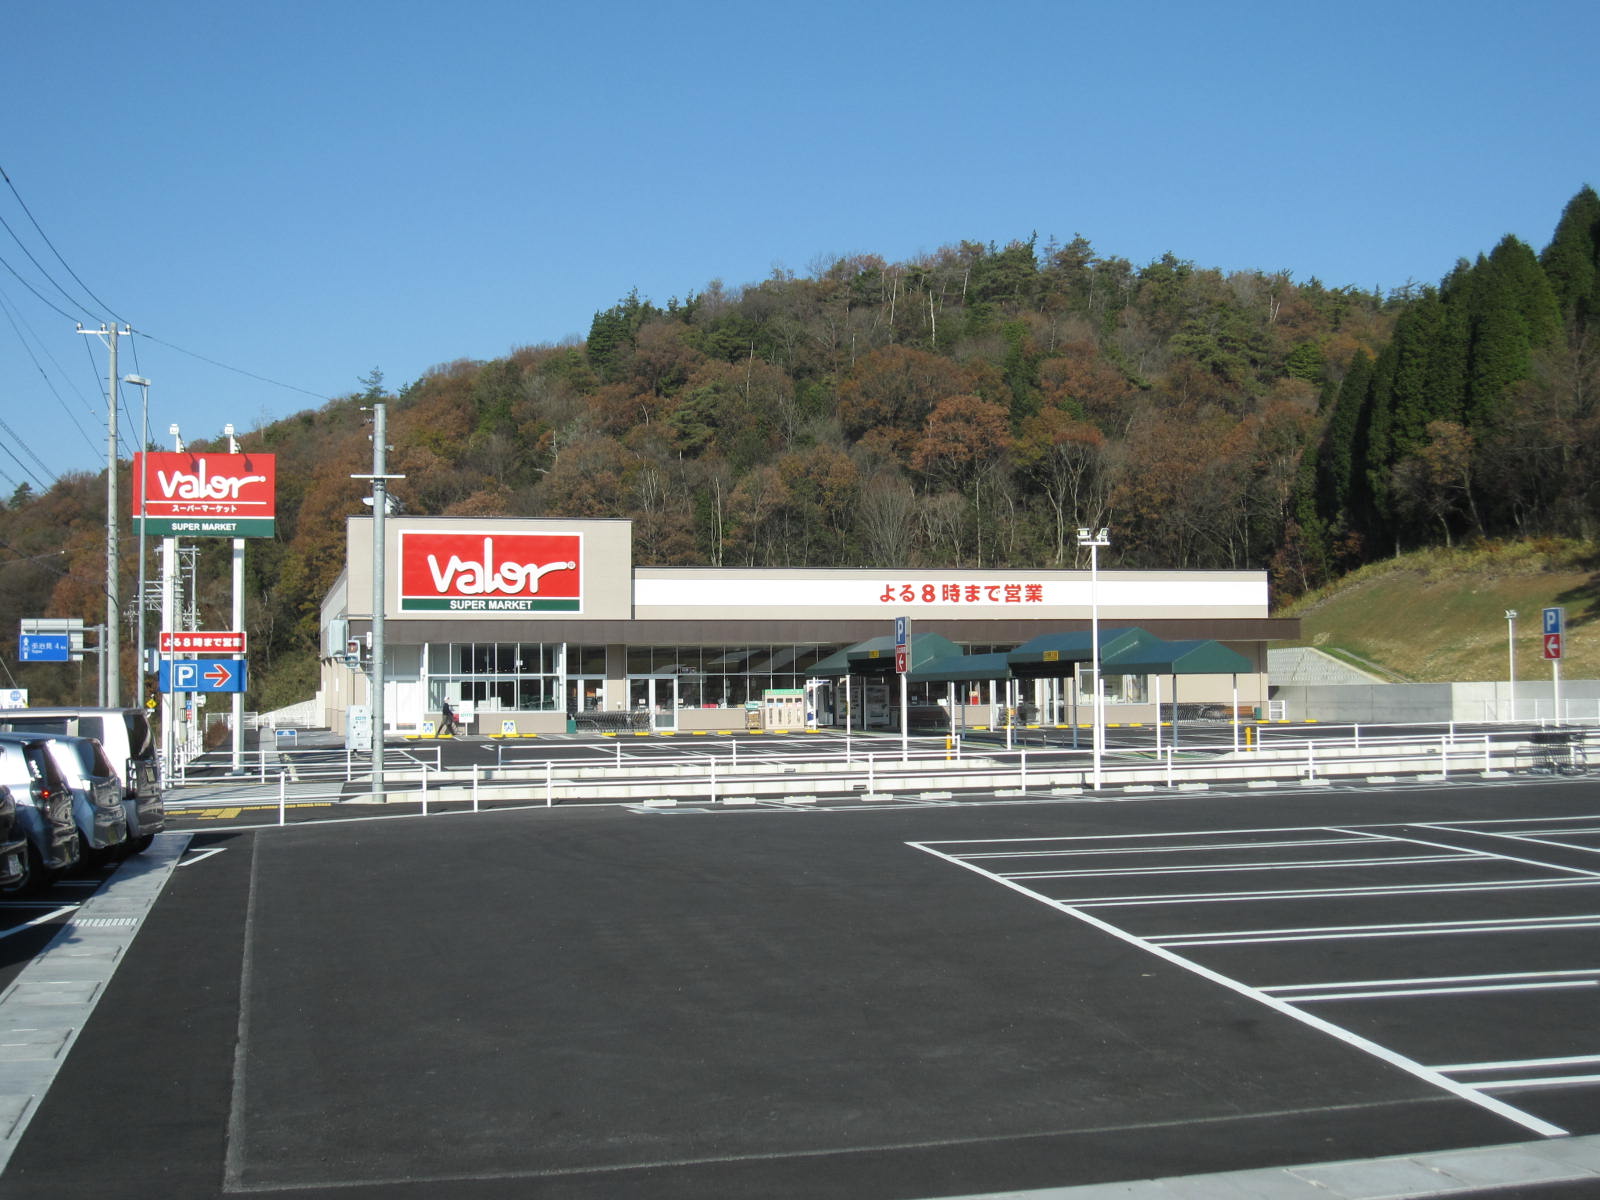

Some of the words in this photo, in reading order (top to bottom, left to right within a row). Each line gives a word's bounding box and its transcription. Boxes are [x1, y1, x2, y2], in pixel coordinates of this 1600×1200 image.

[172, 504, 237, 513] スーパーマーケット
[171, 523, 201, 531] SUPER
[202, 523, 237, 531] MARKET
[879, 584, 1044, 603] よる8時まで営業
[450, 600, 486, 610] SUPER
[488, 600, 533, 610] MARKET
[897, 620, 904, 642] P
[1547, 611, 1556, 632] P
[178, 666, 194, 686] P
